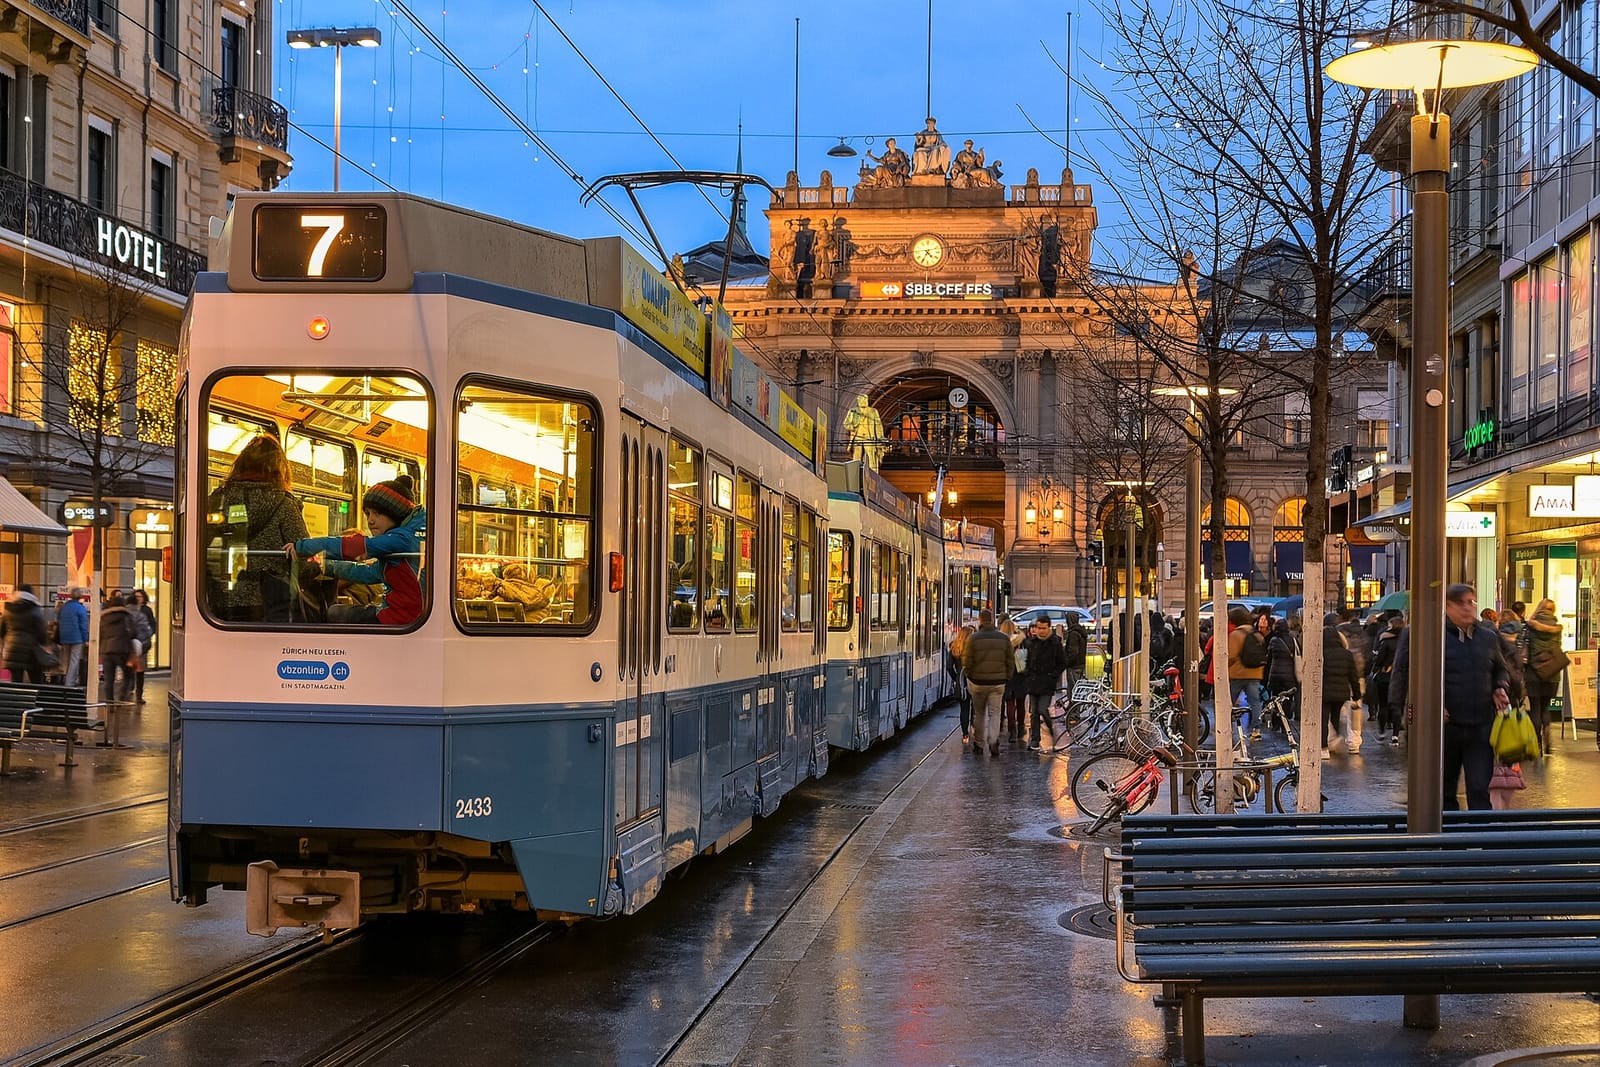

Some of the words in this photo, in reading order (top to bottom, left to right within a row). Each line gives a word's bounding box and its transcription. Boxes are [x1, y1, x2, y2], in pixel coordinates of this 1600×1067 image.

[97, 216, 167, 279] HOTEL
[301, 215, 345, 276] 7
[905, 282, 933, 295] SBB
[936, 282, 963, 295] CFF
[966, 282, 992, 295] FFS
[953, 393, 965, 403] 12
[281, 647, 308, 655] ZÜRICH
[281, 665, 325, 675] vbzonline
[333, 666, 347, 676] .ch
[455, 796, 492, 819] 2433
